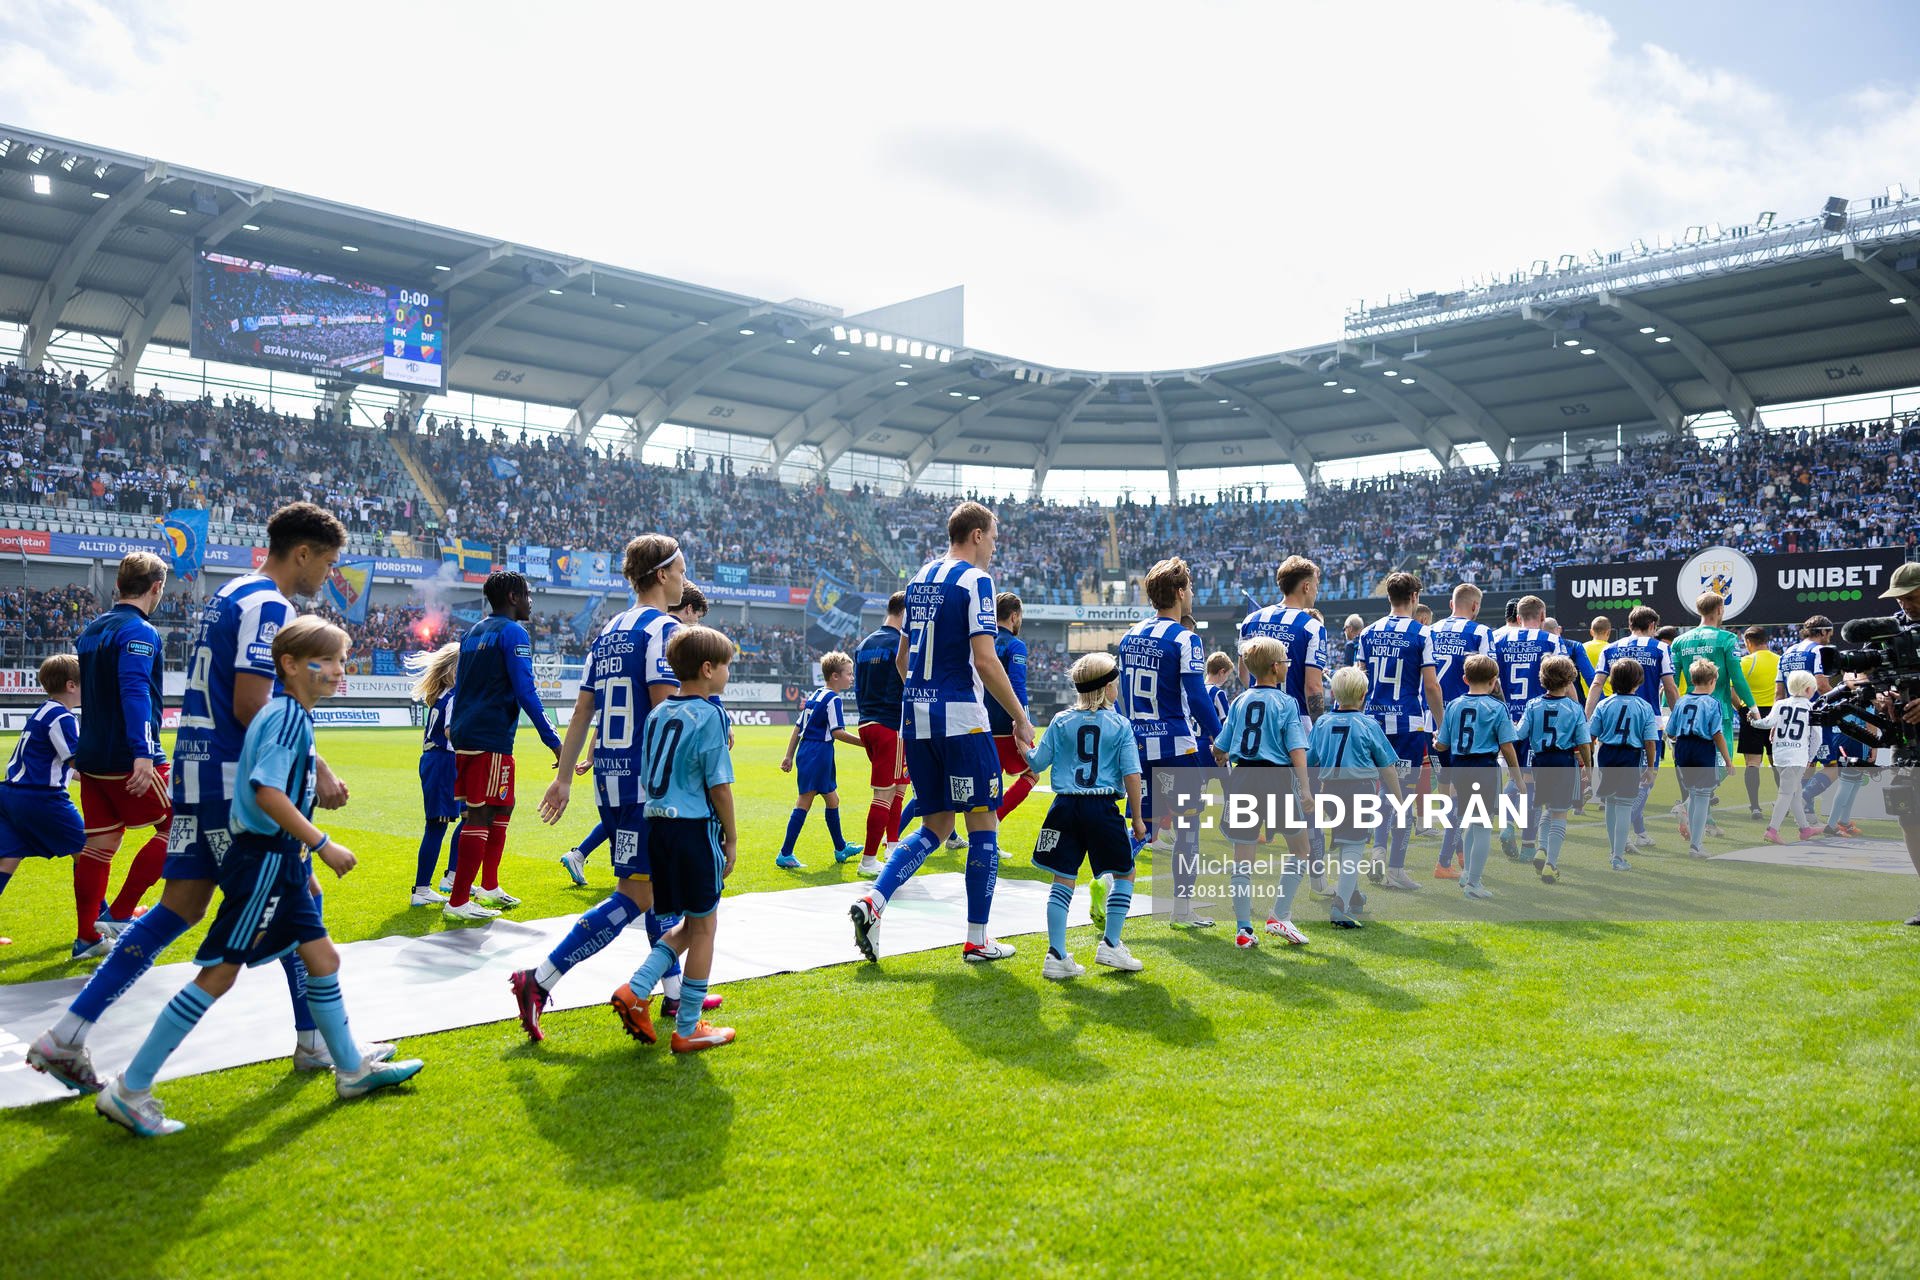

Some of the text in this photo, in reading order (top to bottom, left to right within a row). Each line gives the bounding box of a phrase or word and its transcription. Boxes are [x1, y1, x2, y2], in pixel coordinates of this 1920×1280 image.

[400, 289, 429, 307] 0:00
[396, 308, 404, 322] 0
[424, 314, 432, 327] 0
[392, 327, 407, 337] IFK
[421, 332, 435, 342] DIF
[263, 343, 327, 364] STÅR VI KVAR
[311, 366, 342, 378] SAMSUNG
[1824, 364, 1863, 381] D4
[708, 406, 734, 419] B3
[1559, 403, 1590, 417] D3
[78, 540, 117, 553] ALLTID
[204, 550, 229, 560] LATS
[374, 561, 423, 574] NORDSTAN
[1777, 564, 1884, 590] UNIBET
[913, 584, 941, 595] NORDIC
[1570, 576, 1659, 599] UNIBET
[908, 594, 945, 605] WELLNESS
[1258, 623, 1289, 633] NORDIC
[1373, 631, 1404, 640] NORDIC
[1436, 632, 1461, 640] ORDIC
[1127, 636, 1159, 649] NORDIC
[1365, 638, 1410, 648] WELLNESS
[1436, 638, 1467, 647] LLNESS
[249, 646, 273, 654] UNIB
[1121, 644, 1164, 659] WELLNESS
[1372, 645, 1401, 658] NORLIN
[1436, 645, 1465, 657] KSSON
[1501, 646, 1542, 654] WELLNESS
[1611, 651, 1651, 659] WELLNESS
[1681, 645, 1714, 657] DAHLBERG
[1125, 653, 1160, 671] MUCOLLI
[1368, 656, 1404, 702] 14
[1510, 663, 1531, 700] 5
[349, 683, 414, 691] STENFASTIG
[905, 687, 939, 698] NTAKT
[1125, 667, 1160, 721] 19
[730, 710, 771, 726] YGG
[1777, 705, 1809, 741] 35
[1131, 722, 1168, 732] ONTAKT
[1239, 700, 1266, 758] 8
[1457, 707, 1477, 754] 6
[1541, 710, 1559, 751] 5
[1614, 705, 1631, 746] 4
[1075, 724, 1101, 789] 9
[1331, 725, 1351, 778] 7
[593, 758, 632, 769] ONTAKT
[646, 718, 684, 800] 10
